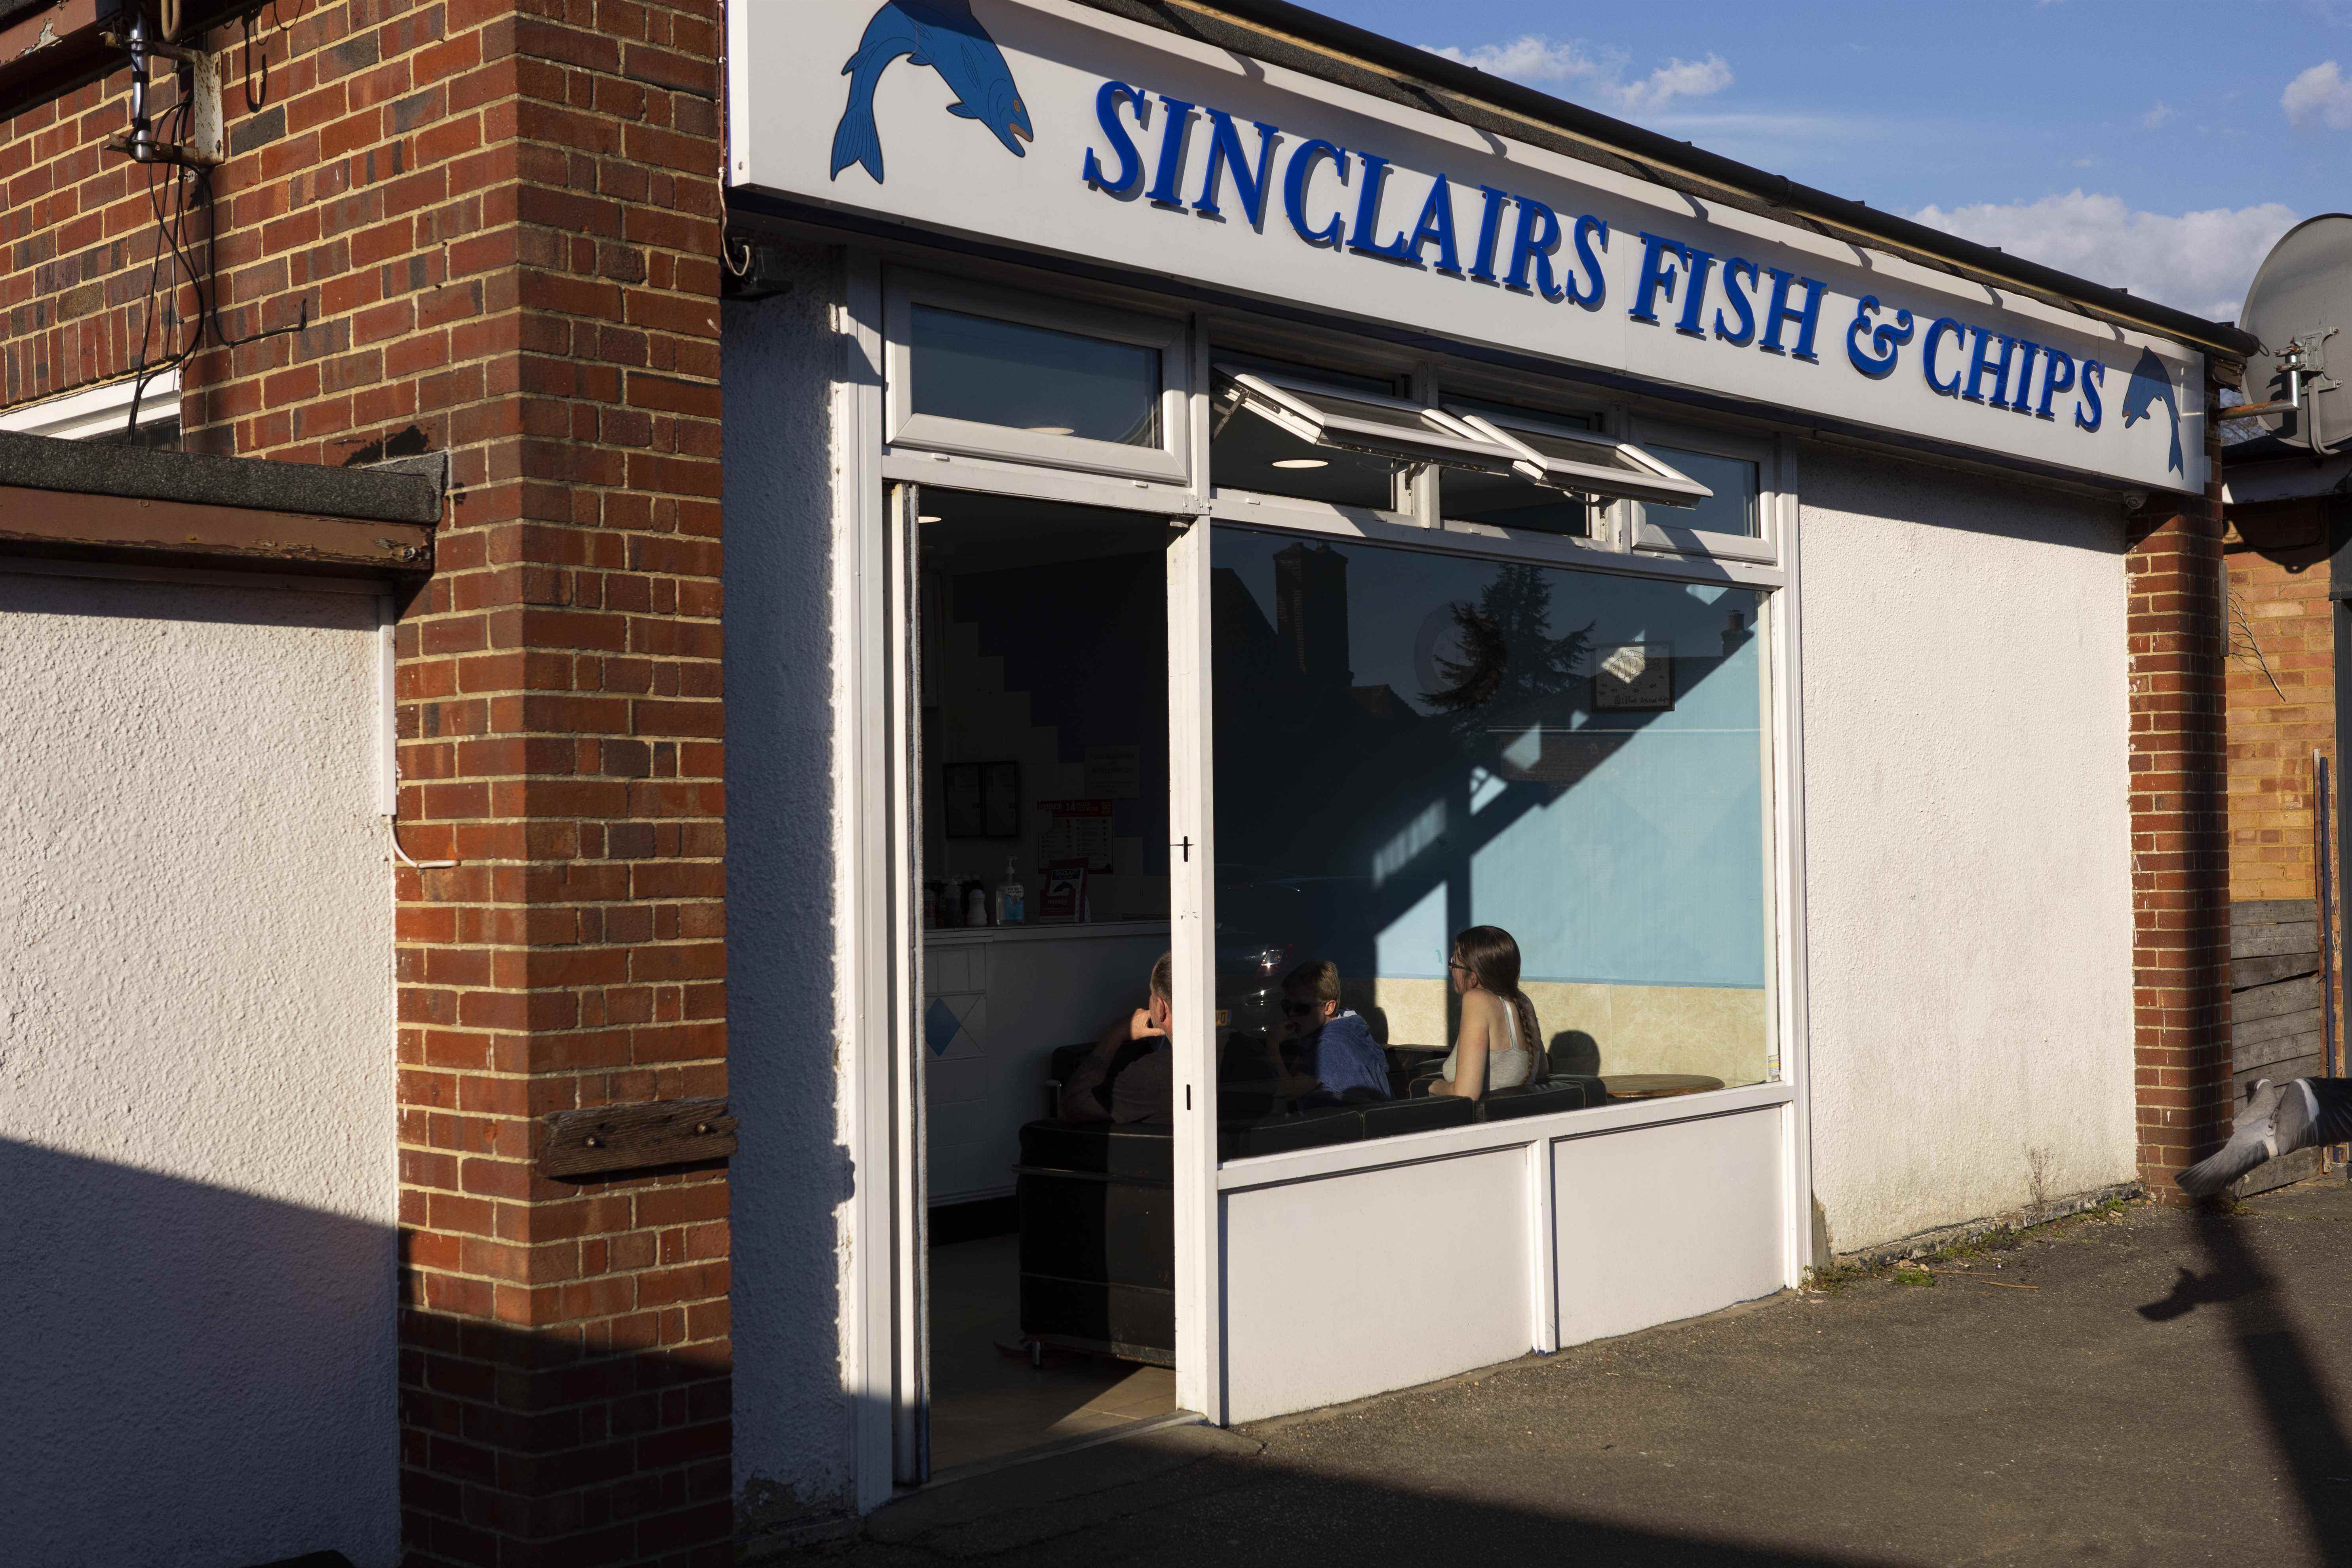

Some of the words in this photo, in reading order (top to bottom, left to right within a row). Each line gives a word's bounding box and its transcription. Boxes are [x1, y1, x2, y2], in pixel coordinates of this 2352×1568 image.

[1082, 80, 1608, 304] SINCLAIRS
[1628, 231, 1828, 358] FISH
[1846, 295, 1914, 374] &
[1923, 318, 2105, 428] CHIPS
